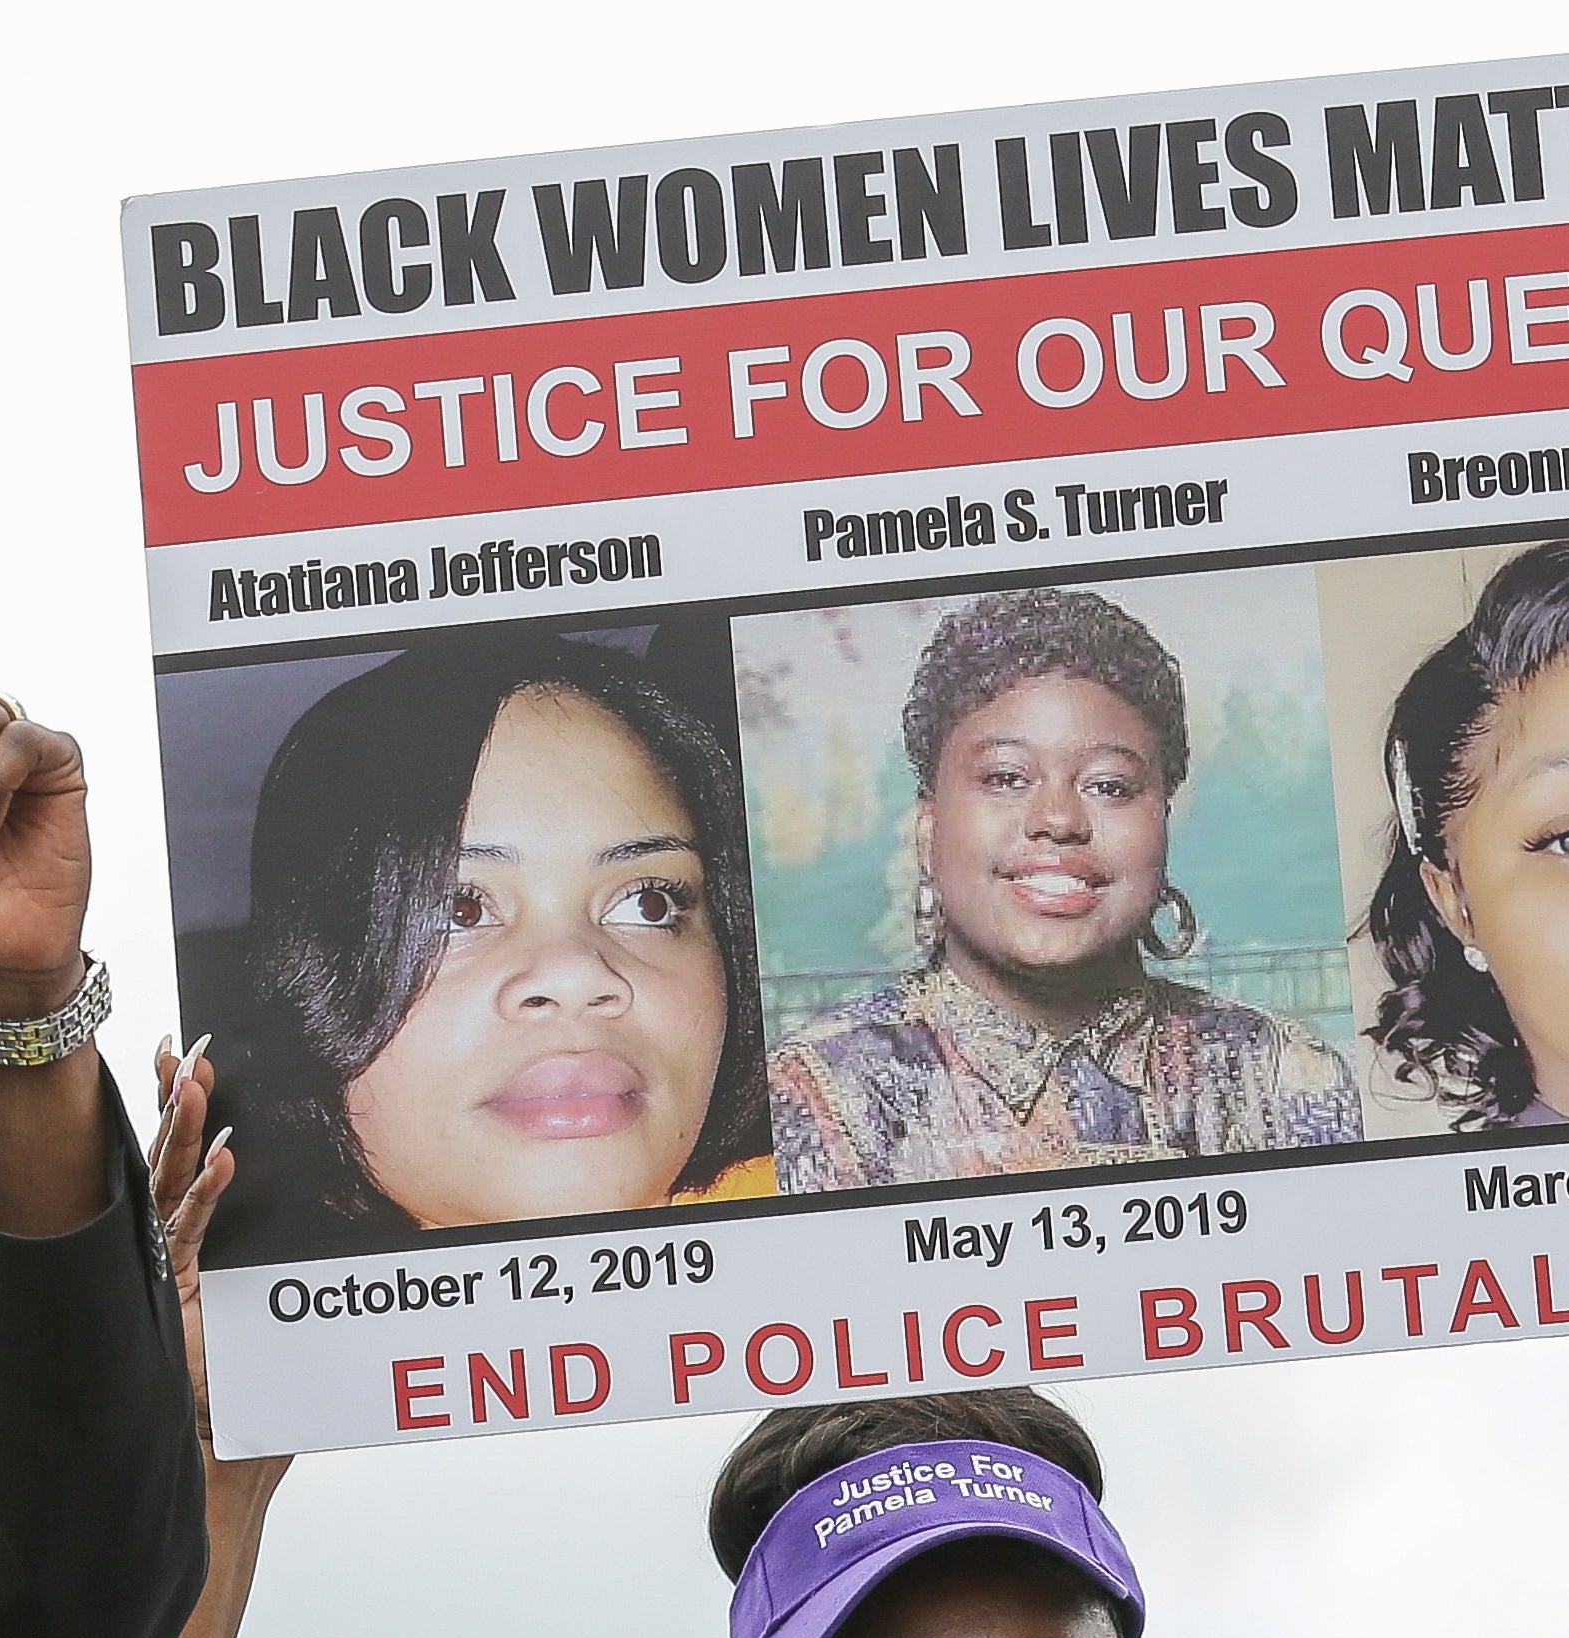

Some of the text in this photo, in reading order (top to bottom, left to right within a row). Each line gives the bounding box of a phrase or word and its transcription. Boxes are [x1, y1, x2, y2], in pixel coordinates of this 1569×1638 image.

[150, 189, 516, 336] BLACK
[532, 142, 969, 295] WOMEN
[994, 111, 1298, 251] LIVES
[183, 356, 689, 494] JUSTICE
[728, 331, 983, 440] FOR
[1016, 301, 1286, 410] OUR
[804, 478, 1230, 561] Pamela S. Turner
[209, 533, 663, 622] Atatiana Jefferson
[904, 1189, 1248, 1269] May 13, 2019
[268, 1240, 715, 1323] October 12, 2019
[392, 1342, 612, 1431] END
[669, 1296, 1084, 1404] POLICE
[813, 1478, 1053, 1549] Pamela Turner
[832, 1454, 1024, 1506] Justice For
